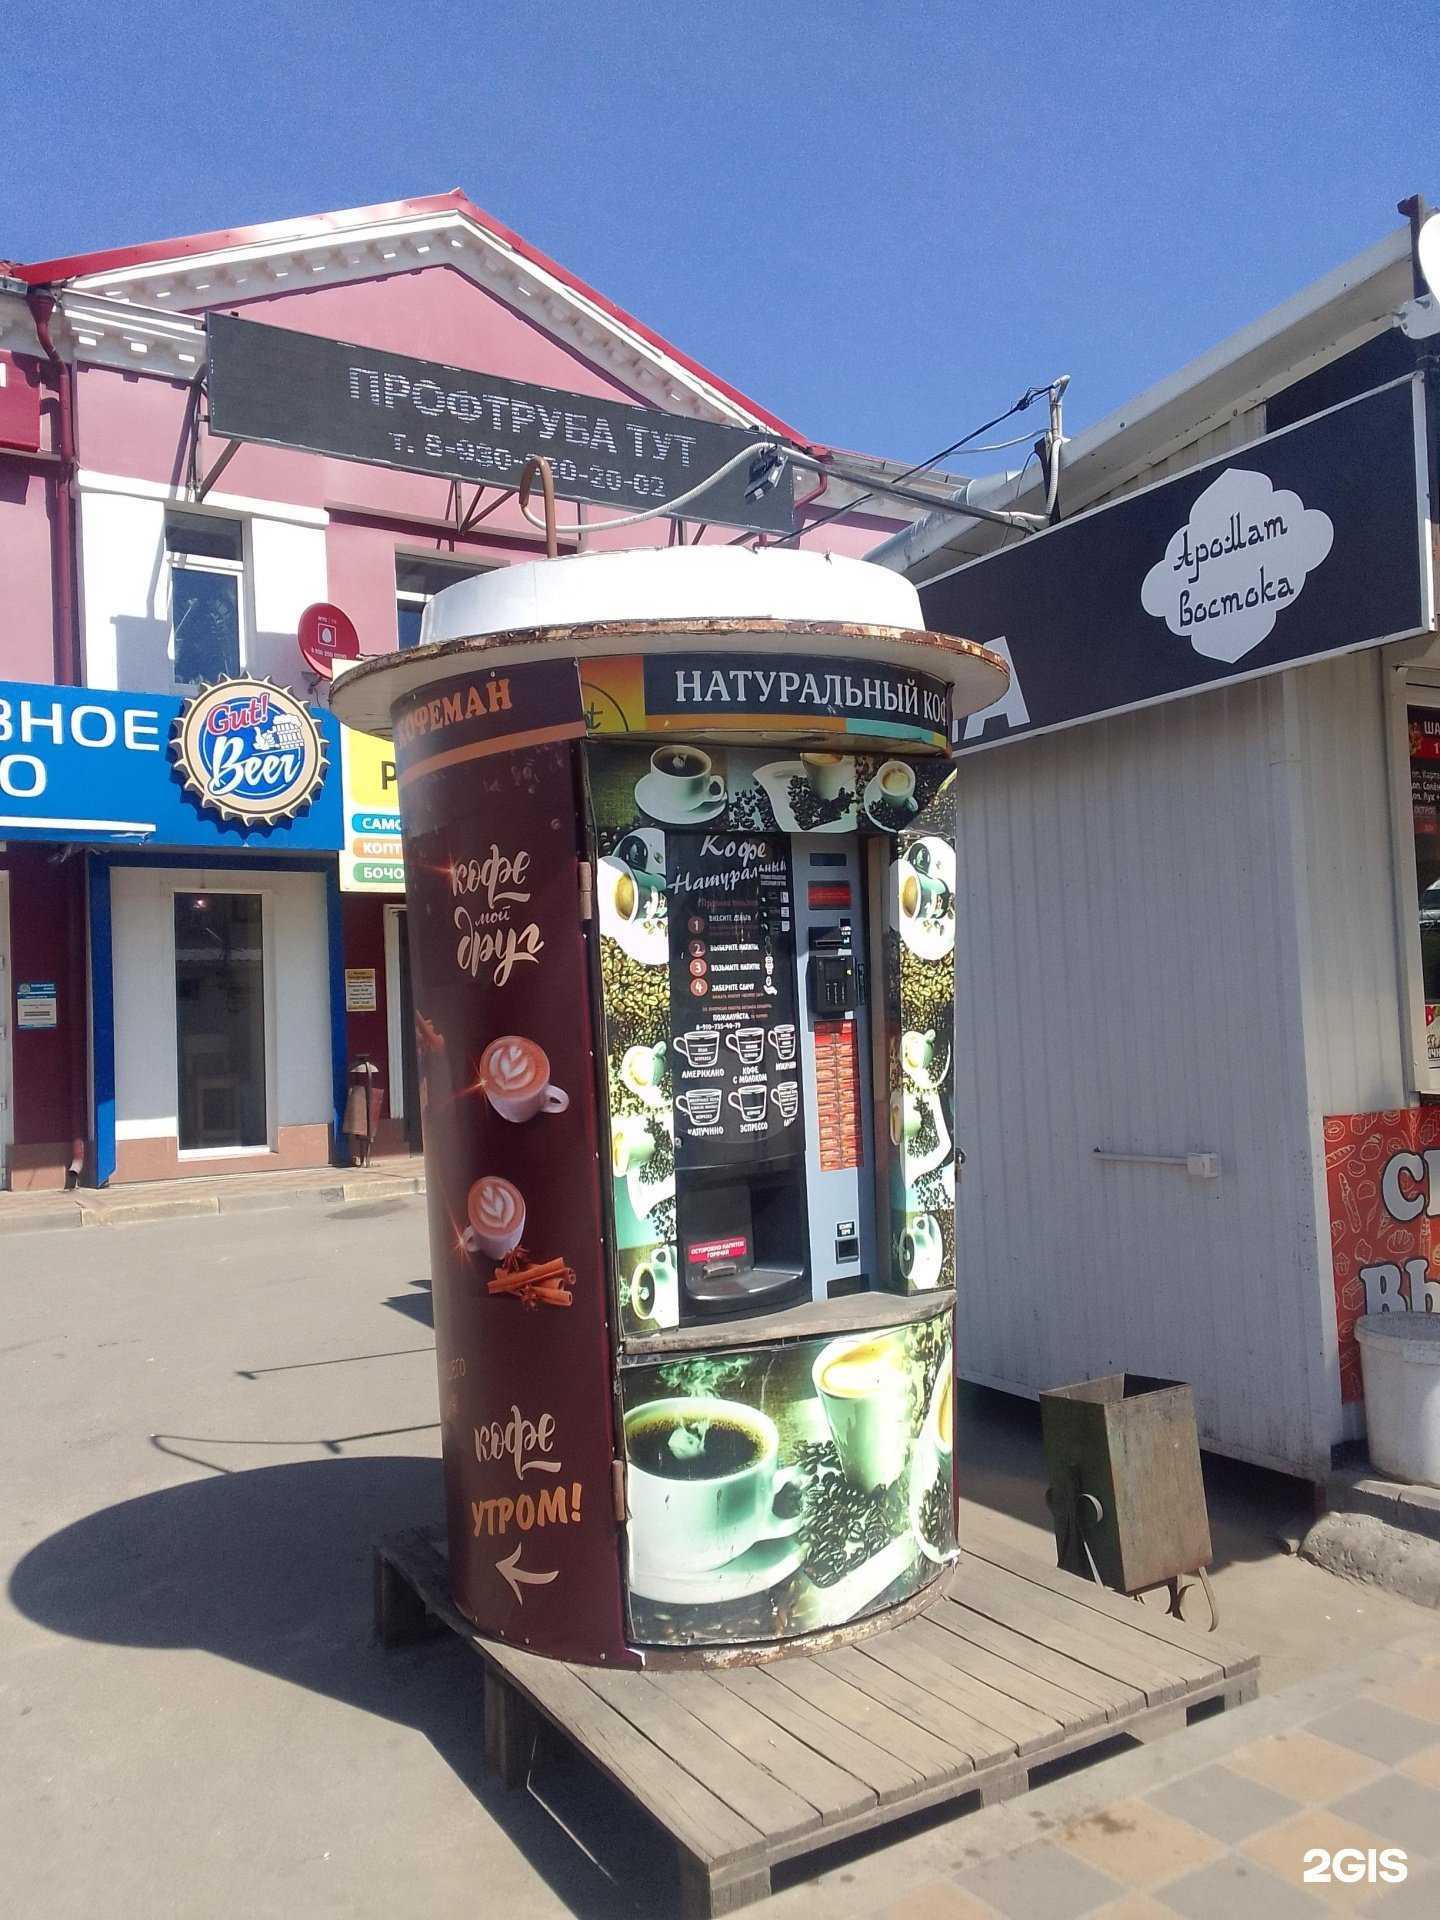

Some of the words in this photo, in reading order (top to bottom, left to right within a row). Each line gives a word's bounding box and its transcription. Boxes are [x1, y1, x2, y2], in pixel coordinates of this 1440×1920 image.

[349, 366, 618, 456] ПРОФТРУБА
[626, 422, 697, 470] ТУТ
[207, 691, 270, 735] Gut!
[675, 669, 918, 716] НАТУРАЛЬНЫЙ
[207, 735, 301, 797] Beer
[700, 834, 767, 868] Кофе
[452, 843, 531, 909] кофе
[474, 904, 511, 927] мой
[454, 905, 545, 987] друг
[694, 943, 706, 957] 2
[694, 961, 703, 973] 3
[694, 980, 703, 993] 4
[681, 1067, 725, 1079] АМЕРИКАНО
[742, 1065, 759, 1075] КОФЕ
[473, 1404, 562, 1481] кофе
[471, 1482, 583, 1537] УТРОМ!
